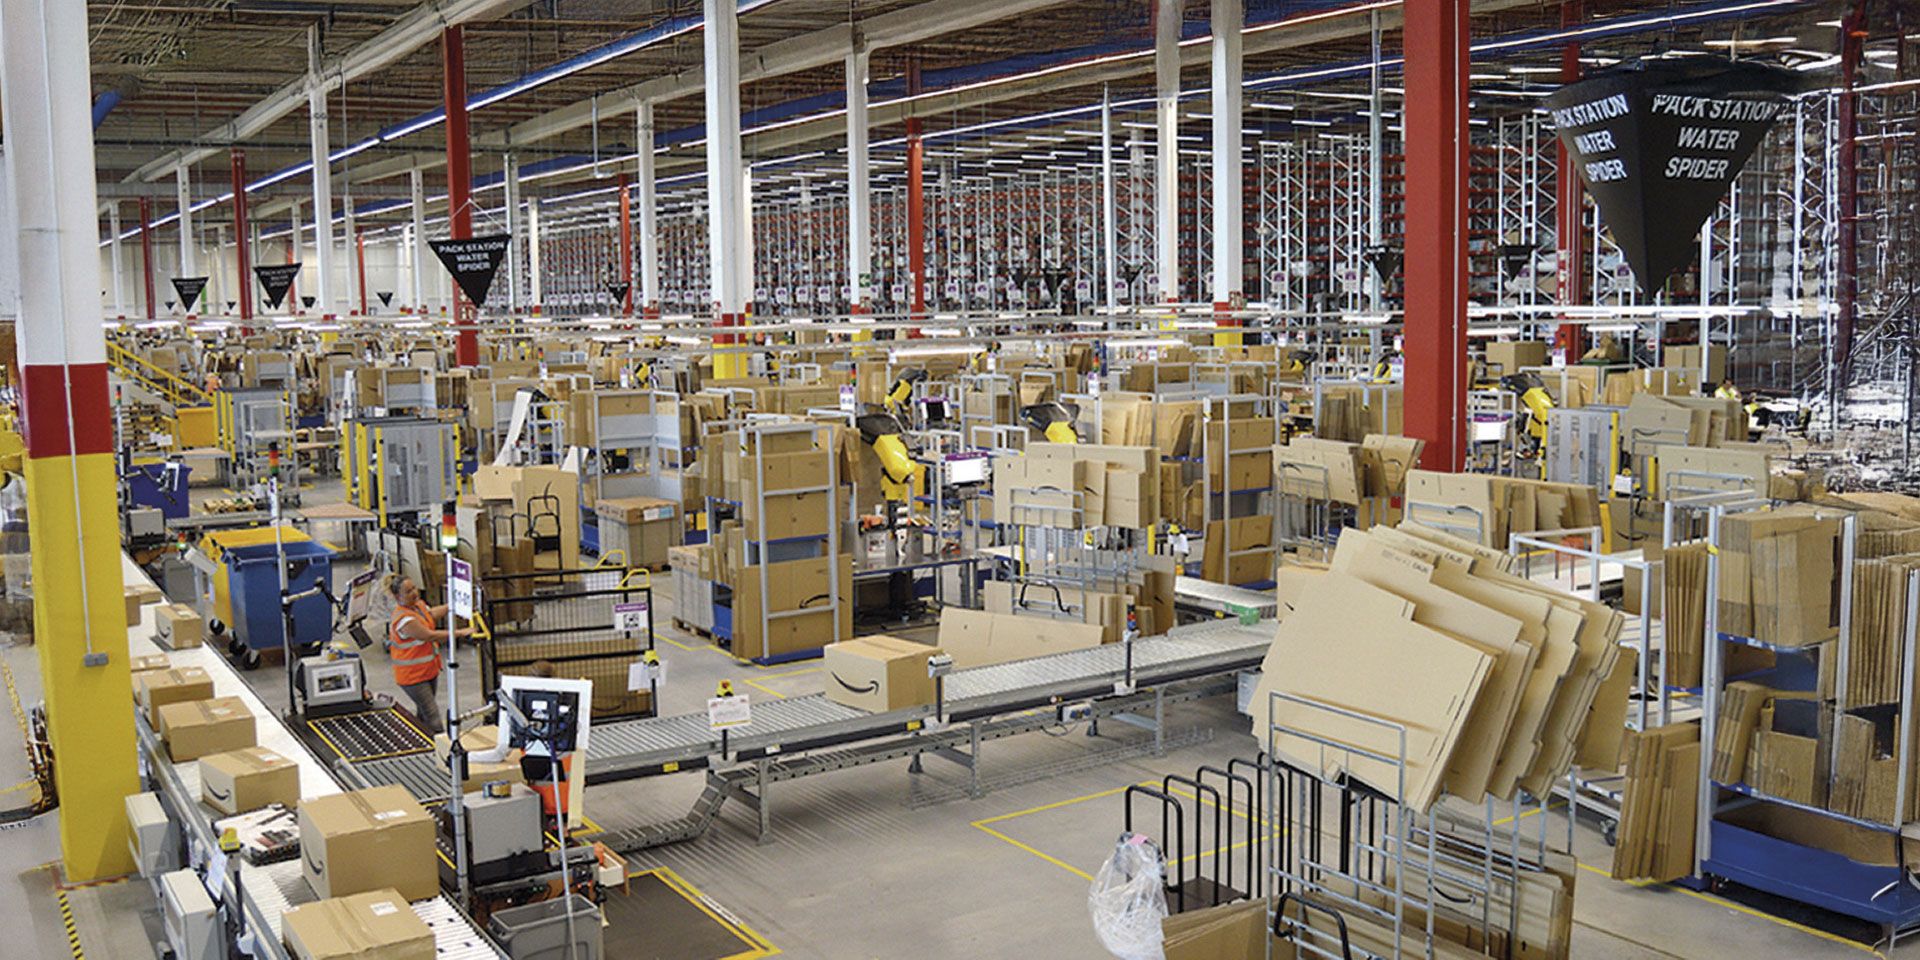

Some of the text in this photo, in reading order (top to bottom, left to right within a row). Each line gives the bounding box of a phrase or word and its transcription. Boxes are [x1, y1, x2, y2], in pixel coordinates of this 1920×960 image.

[1553, 94, 1629, 128] PACK STATION
[1651, 94, 1777, 122] PACK STATION
[1574, 130, 1616, 155] WATER
[1678, 126, 1740, 151] WATER
[1585, 159, 1627, 183] SPIDER
[1665, 156, 1729, 180] SPIDER
[456, 253, 489, 261] WATER
[465, 242, 504, 252] STATION
[457, 263, 491, 271] SPIDER
